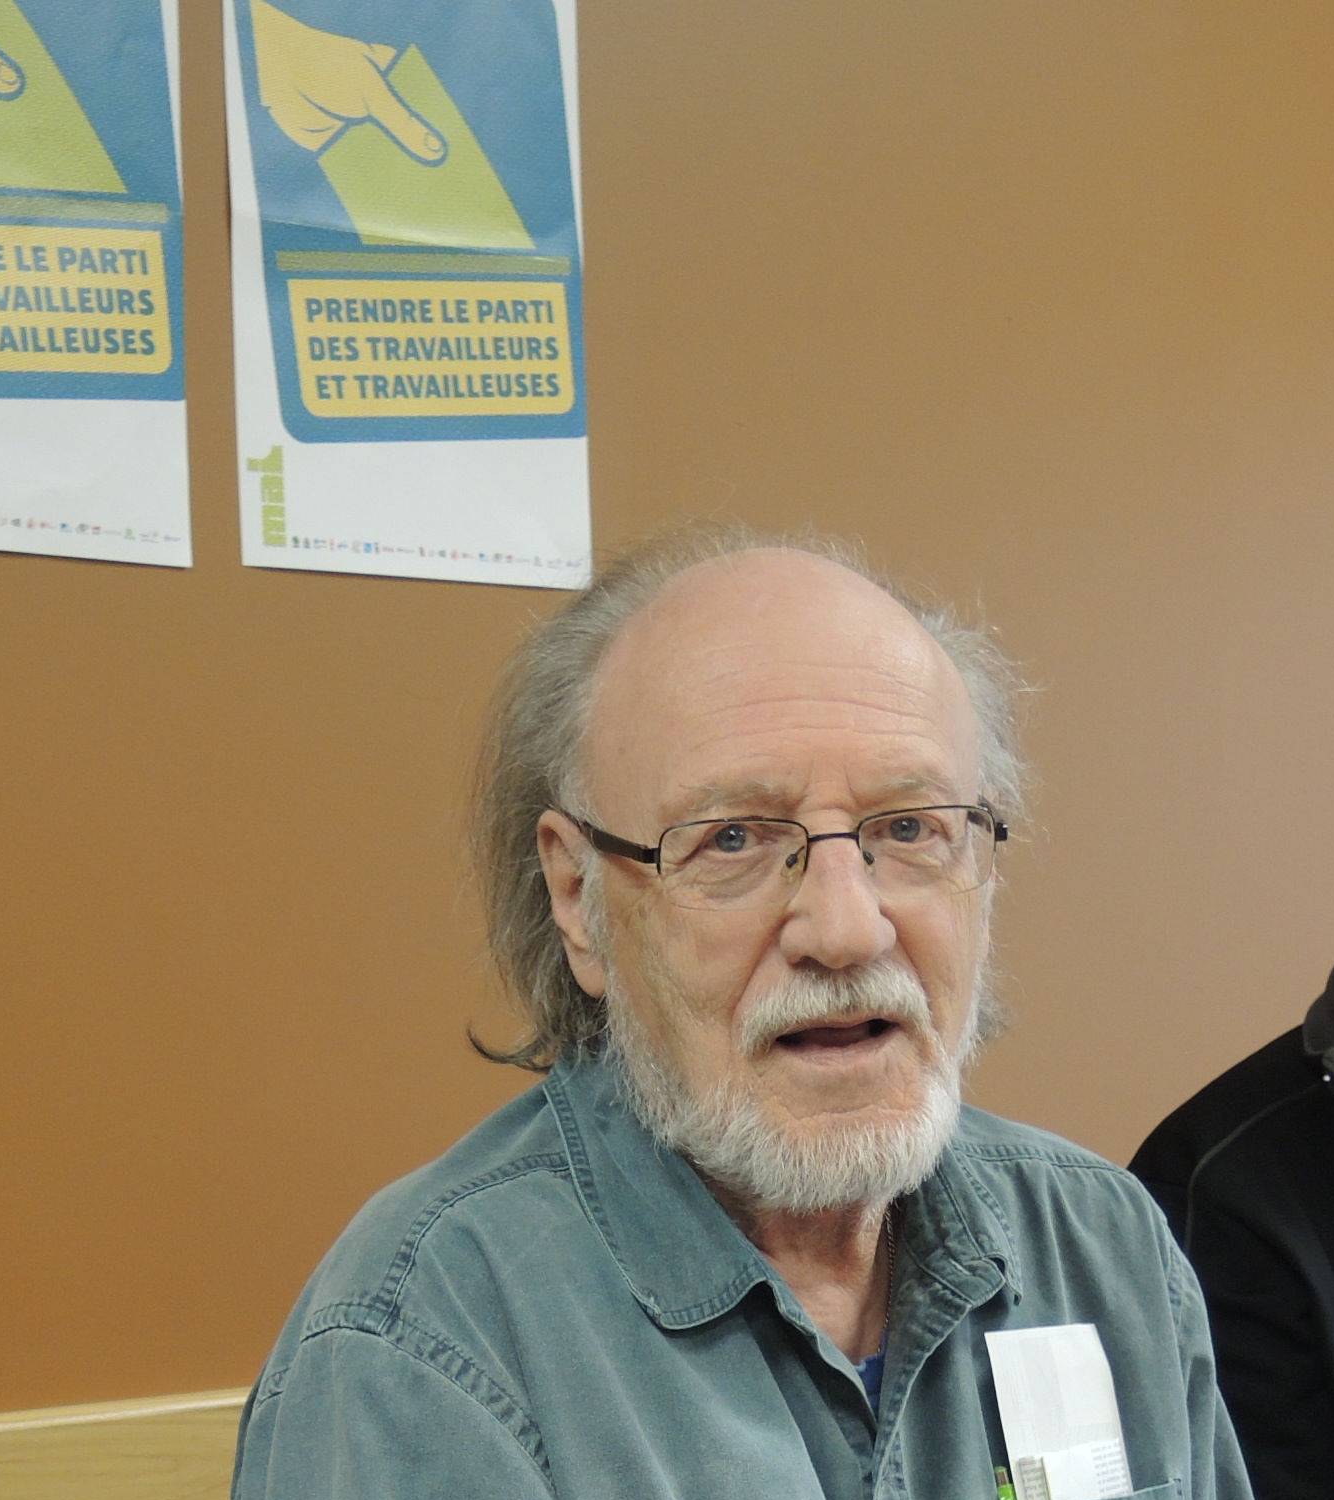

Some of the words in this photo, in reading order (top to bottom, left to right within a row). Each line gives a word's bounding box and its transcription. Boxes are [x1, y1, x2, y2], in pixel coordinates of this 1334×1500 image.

[15, 245, 49, 272] LE
[57, 247, 148, 275] PARTI
[305, 298, 434, 323] PRENDRE
[441, 300, 469, 323] LE
[477, 300, 555, 324] PARTI
[308, 336, 360, 361] DES
[366, 336, 560, 361] TRAVAILLEURS
[315, 375, 346, 400] ET
[354, 373, 561, 399] TRAVAILLEUSES
